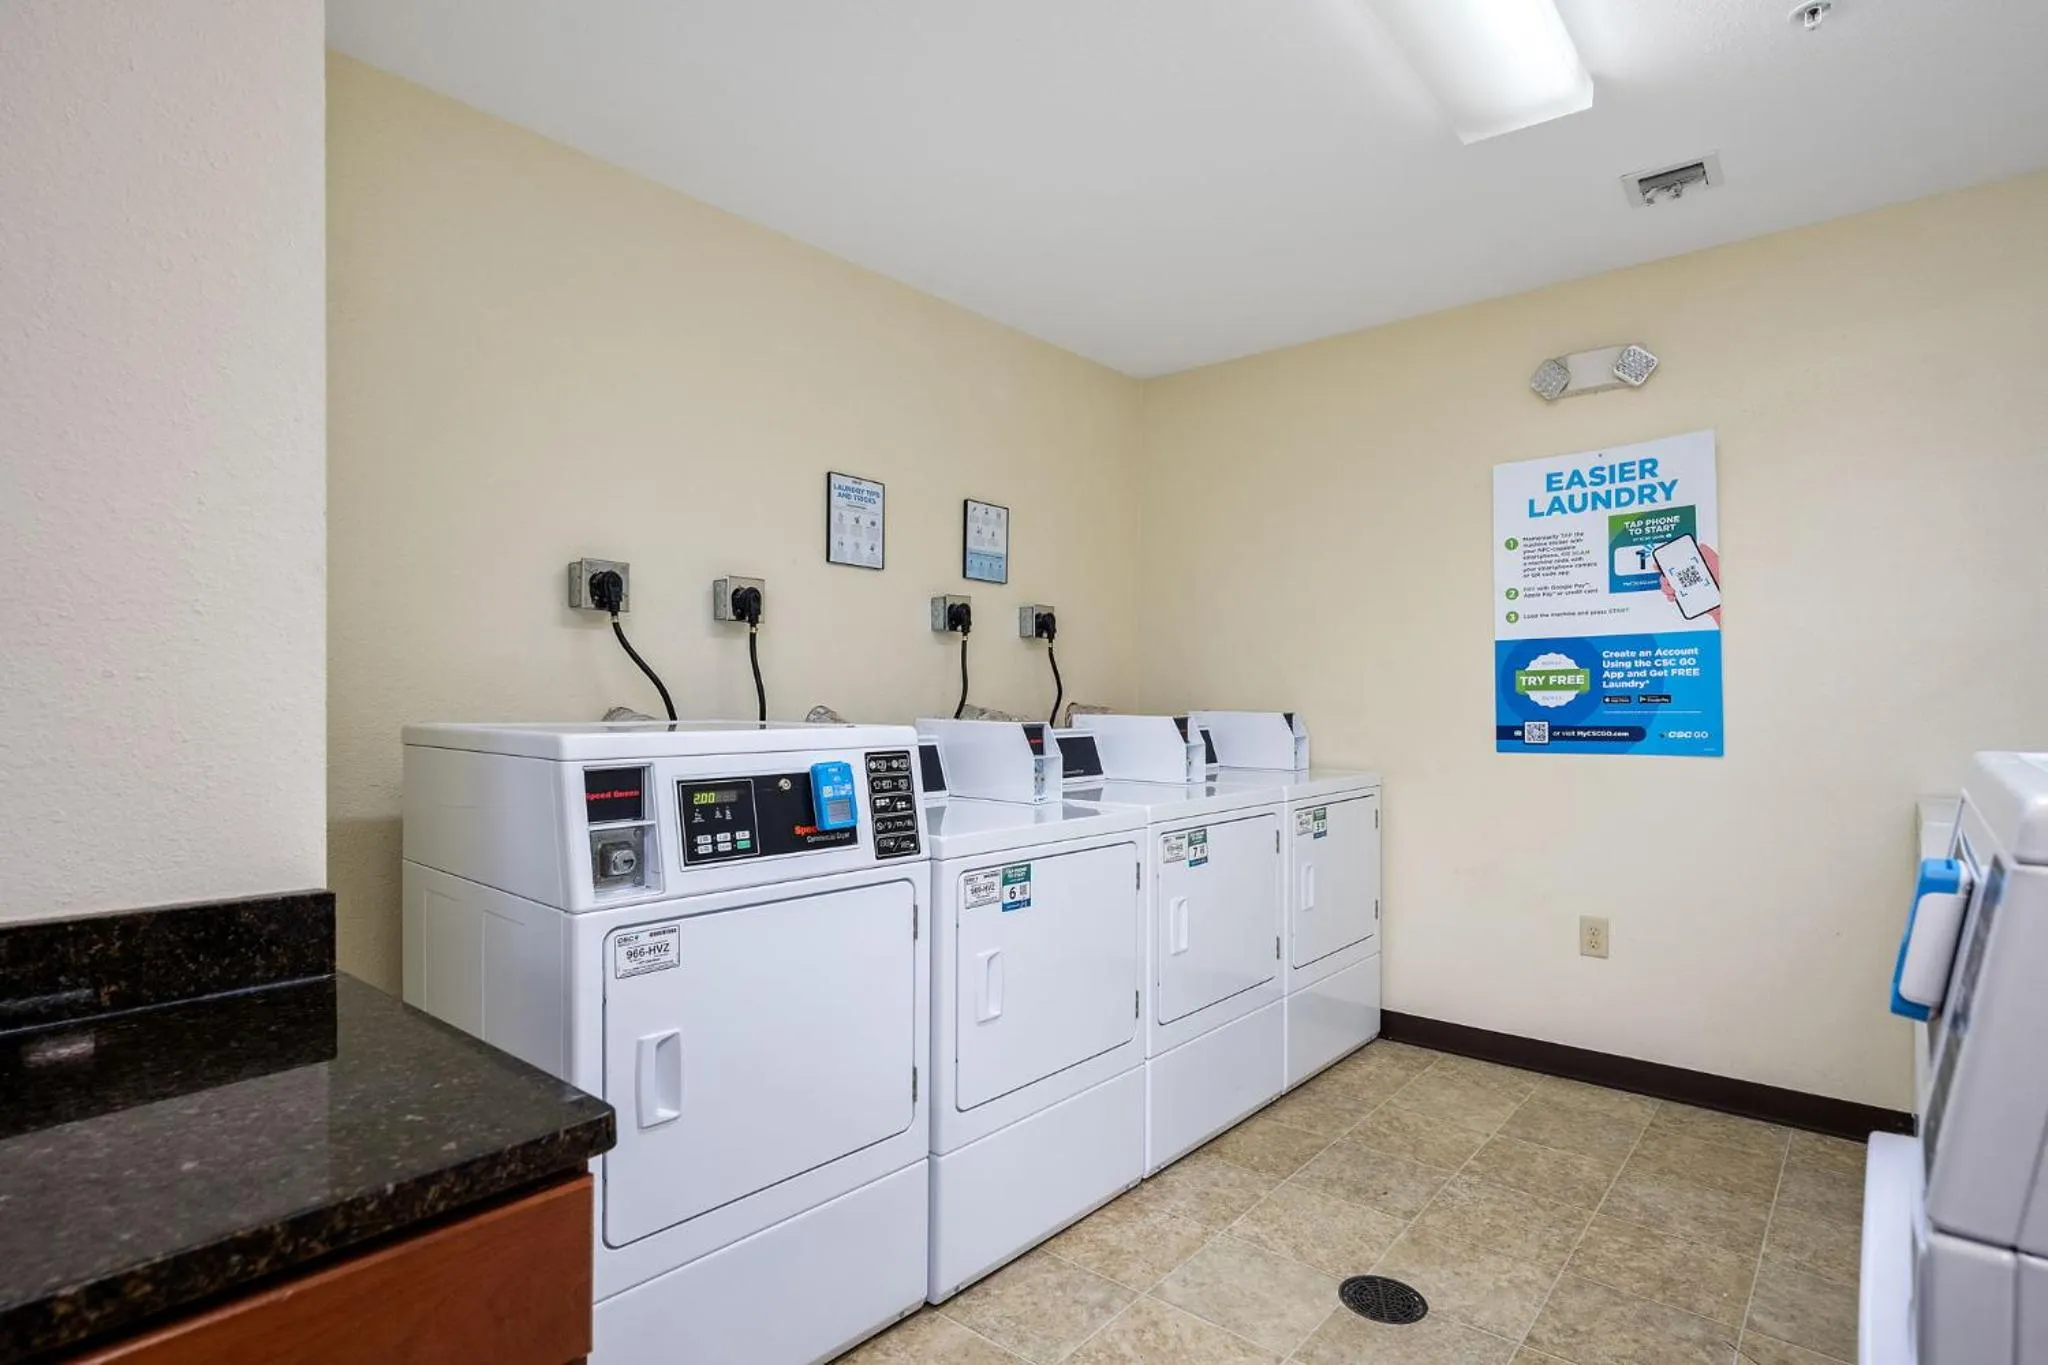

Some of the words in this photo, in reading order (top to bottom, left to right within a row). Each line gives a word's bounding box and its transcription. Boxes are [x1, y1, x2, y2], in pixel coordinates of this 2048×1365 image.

[1546, 457, 1659, 492] EASIER
[1528, 479, 1679, 518] LAUNDRY
[1624, 520, 1643, 529] TAP
[1646, 515, 1680, 525] PHONE
[1628, 528, 1642, 536] TO
[1644, 523, 1676, 535] START
[1636, 549, 1646, 570] 1
[1602, 649, 1636, 658] Create
[1639, 649, 1652, 657] an
[1655, 647, 1699, 656] Account
[1602, 660, 1632, 669] Using
[1634, 659, 1652, 667] the
[1654, 658, 1676, 667] CSC
[1679, 657, 1696, 666] GO
[1520, 675, 1545, 686] TRY
[1549, 674, 1585, 685] FREE
[1602, 670, 1624, 679] App
[1627, 669, 1646, 677] and
[1649, 669, 1668, 677] Get
[1670, 668, 1700, 677] FREE
[1693, 730, 1709, 739] GO
[1193, 847, 1198, 858] 7
[1009, 886, 1017, 900] 6
[626, 943, 670, 960] 966-HVZ
